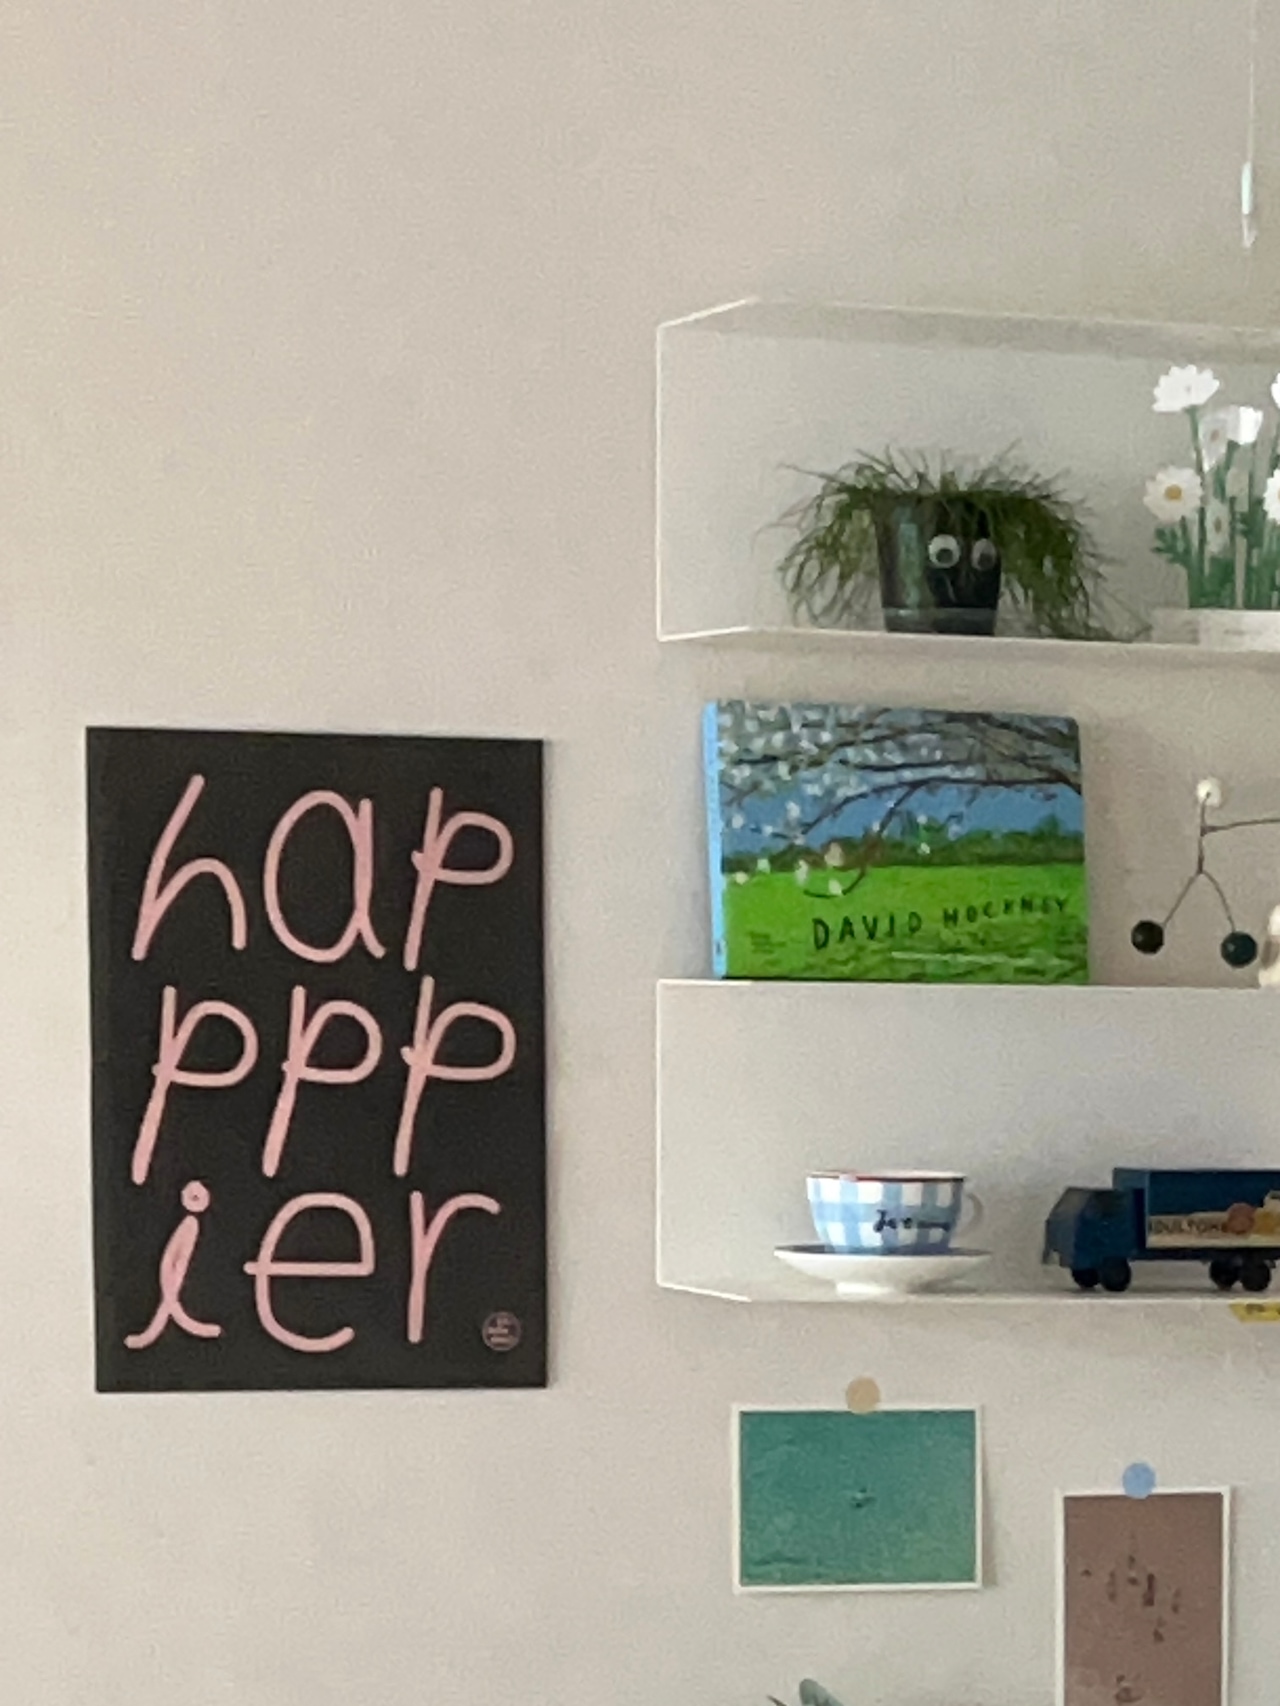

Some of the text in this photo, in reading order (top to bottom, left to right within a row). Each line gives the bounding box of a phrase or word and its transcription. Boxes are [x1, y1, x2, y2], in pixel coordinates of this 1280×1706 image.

[132, 774, 514, 971] hap
[812, 911, 922, 951] DAVID
[131, 966, 516, 1184] ppp
[122, 1179, 500, 1353] ier
